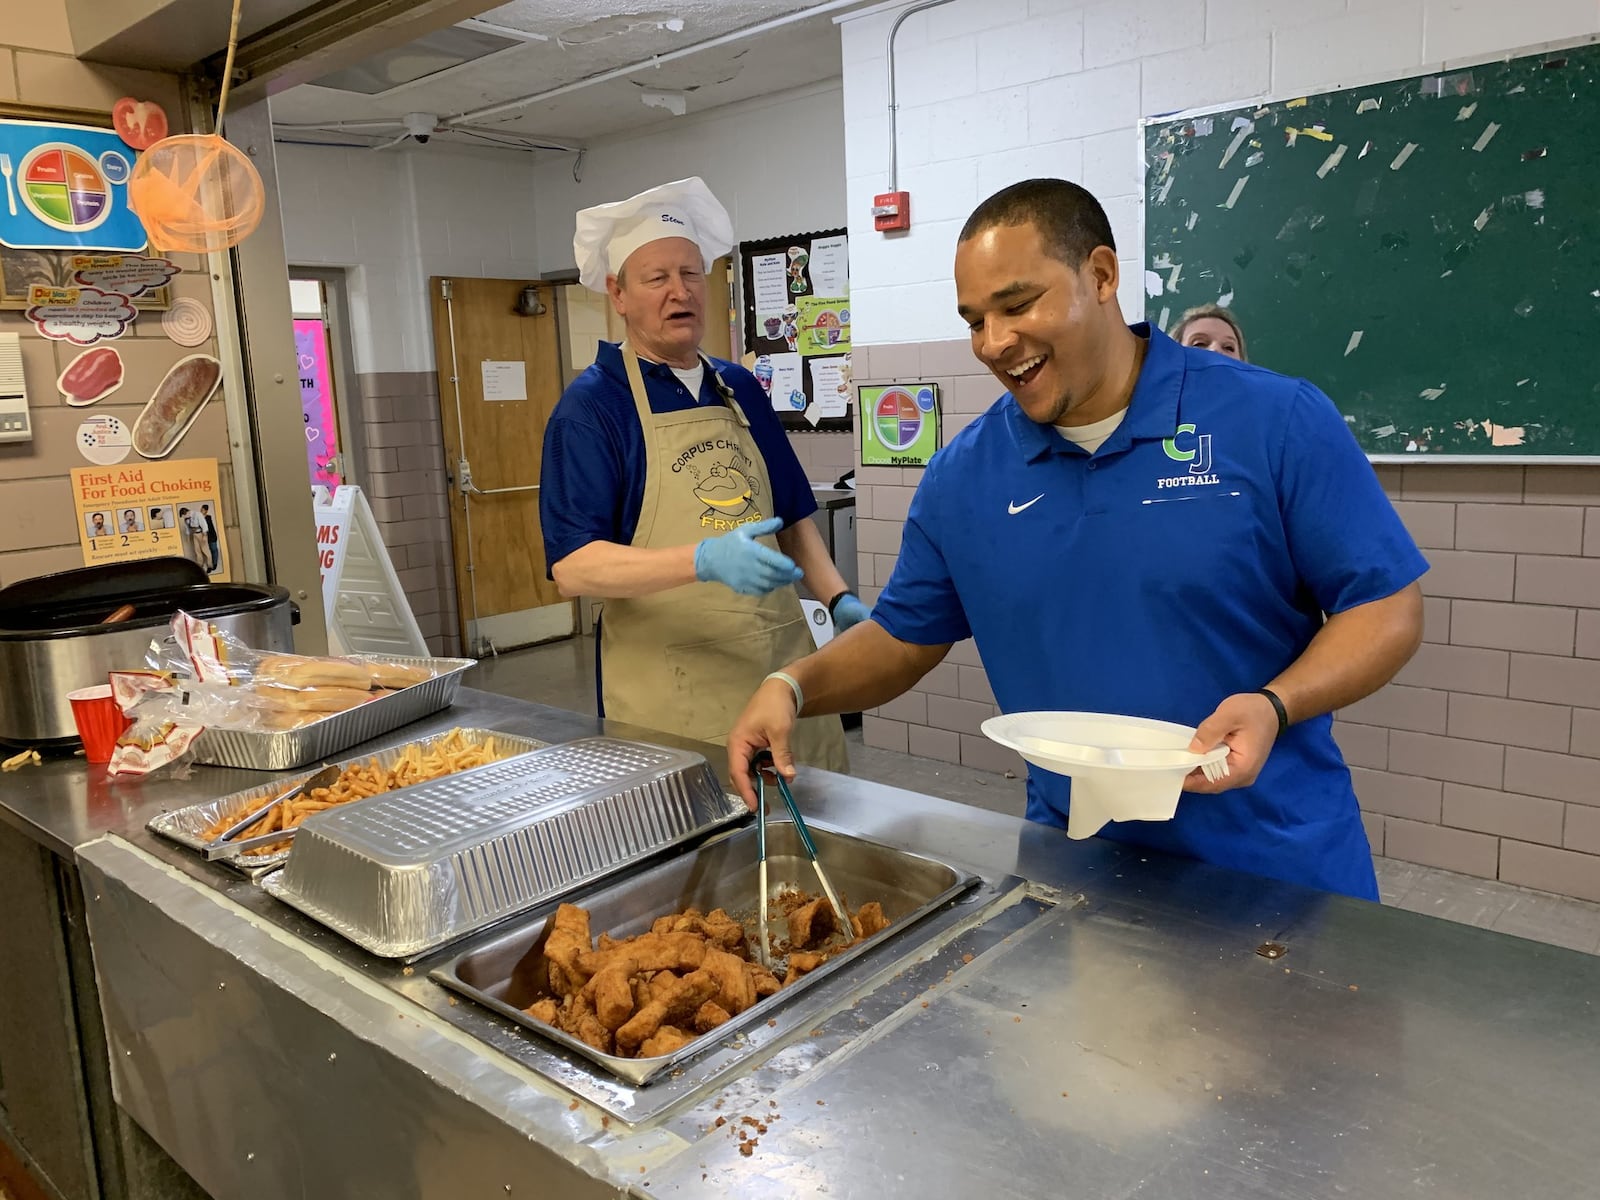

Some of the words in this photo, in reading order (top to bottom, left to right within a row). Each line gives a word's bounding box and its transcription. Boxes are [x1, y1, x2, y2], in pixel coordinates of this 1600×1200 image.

[671, 441, 714, 473] CORPUS
[891, 456, 922, 465] MyPlate
[79, 473, 113, 487] First
[118, 469, 144, 484] Aid
[1157, 474, 1220, 489] FOOTBALL
[82, 487, 107, 501] For
[110, 483, 146, 498] Food
[150, 478, 212, 494] Choking
[120, 535, 131, 547] 2
[150, 531, 160, 544] 3
[89, 539, 97, 551] 1
